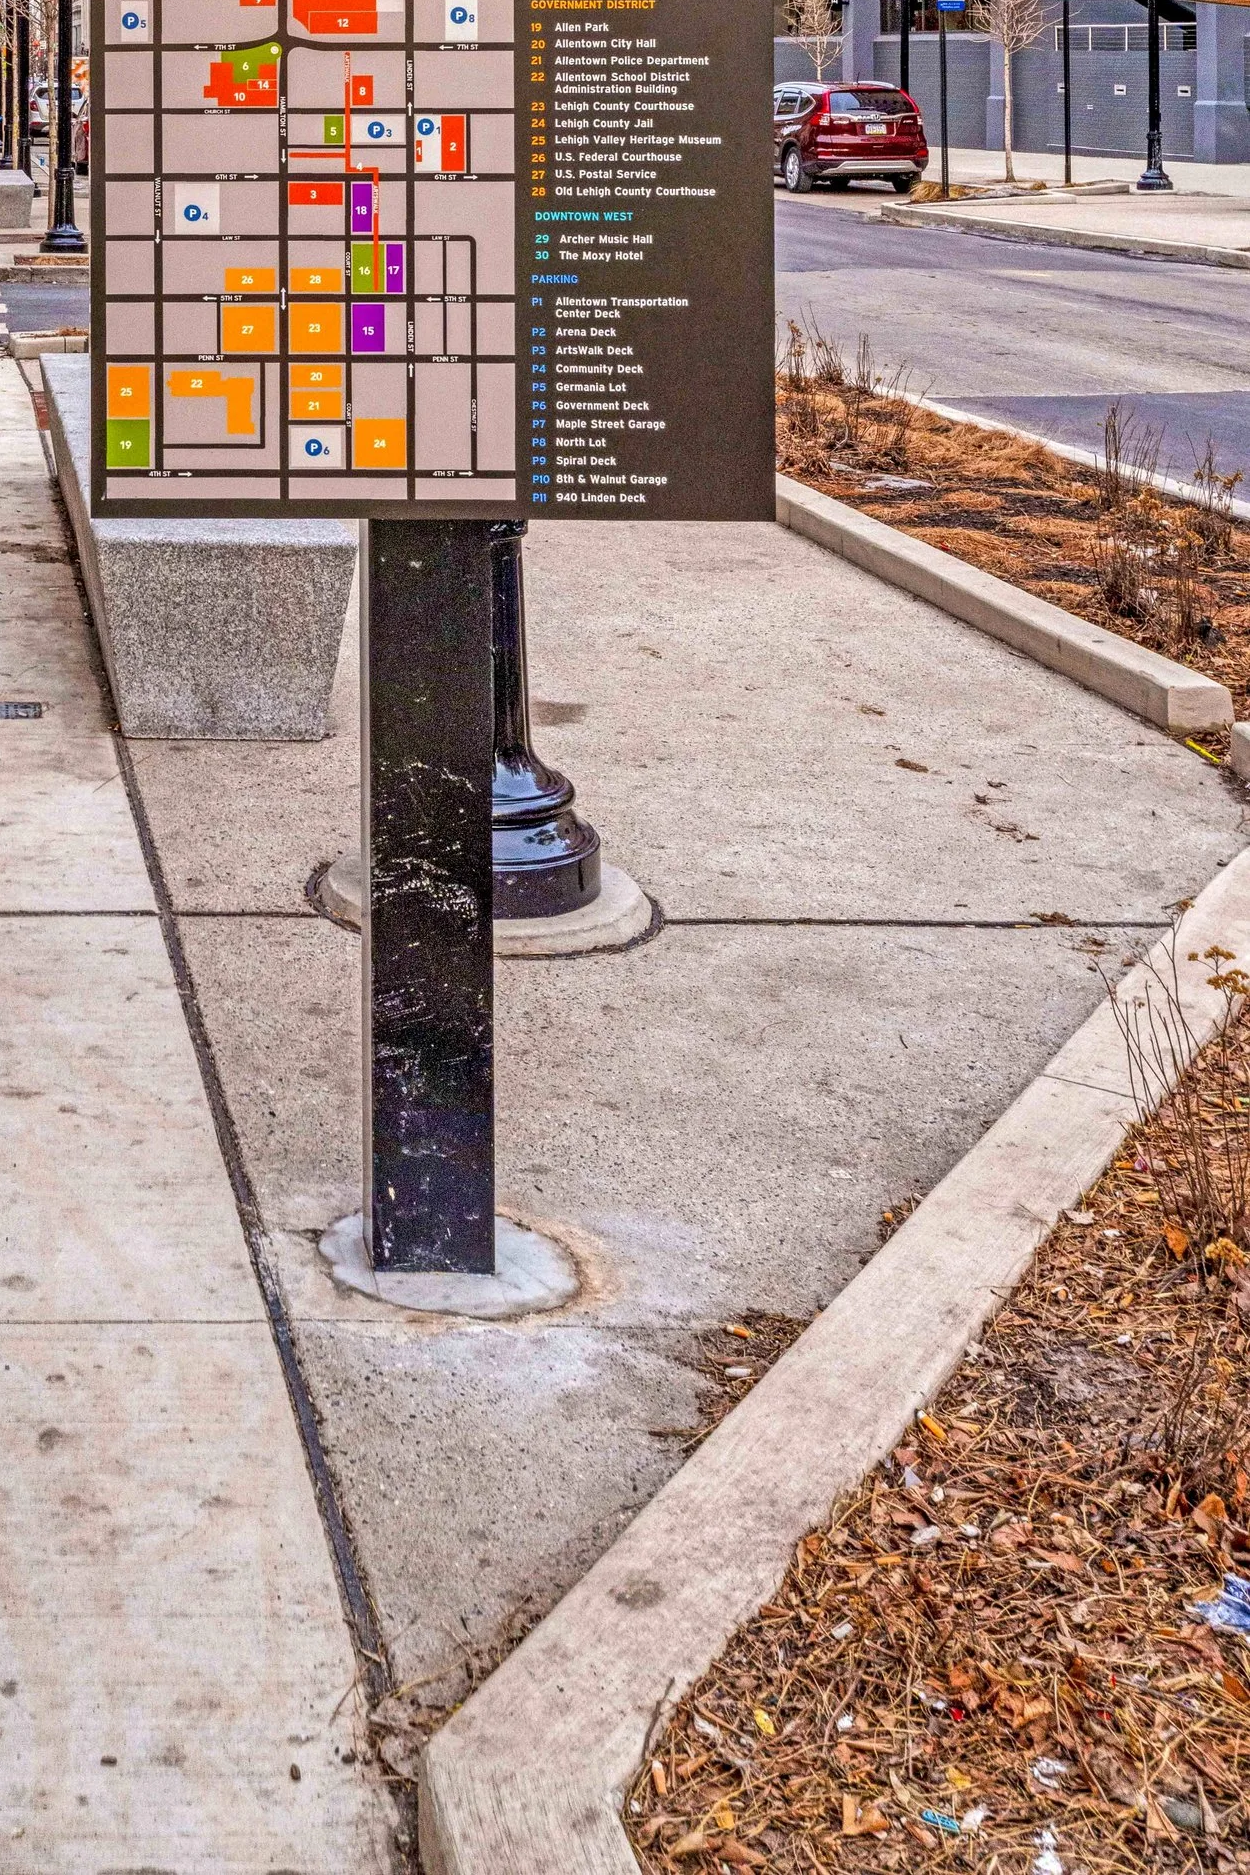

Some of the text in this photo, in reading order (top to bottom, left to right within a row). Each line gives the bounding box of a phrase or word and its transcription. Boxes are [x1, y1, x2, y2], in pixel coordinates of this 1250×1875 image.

[530, 0, 656, 10] GOVERNMENT DISTRICT
[337, 18, 349, 27] 12
[530, 71, 690, 82] 22 Allentown School District
[257, 81, 269, 89] 14
[554, 83, 678, 96] Administration Building
[233, 93, 246, 101] 10
[530, 134, 722, 147] 25 Lehigh Valley Heritage Museum
[531, 186, 717, 199] 28 Old Lehigh County Courthouse
[355, 206, 367, 214] 18
[534, 211, 634, 222] DOWNTOWN WEST
[535, 234, 653, 245] 29 Archer Music Hall
[534, 250, 644, 263] 30 The Moxy Hotel
[358, 266, 370, 275] 16
[388, 266, 399, 275] 17
[241, 276, 253, 284] 26
[531, 274, 579, 285] PARKING
[242, 325, 254, 334] 27
[362, 327, 375, 335] 15
[190, 379, 203, 388] 22
[120, 441, 132, 449] 19
[374, 439, 386, 448] 24
[532, 473, 668, 487] P10 8th & Walnut Garage
[532, 492, 647, 503] P11 940 Linden Deck
